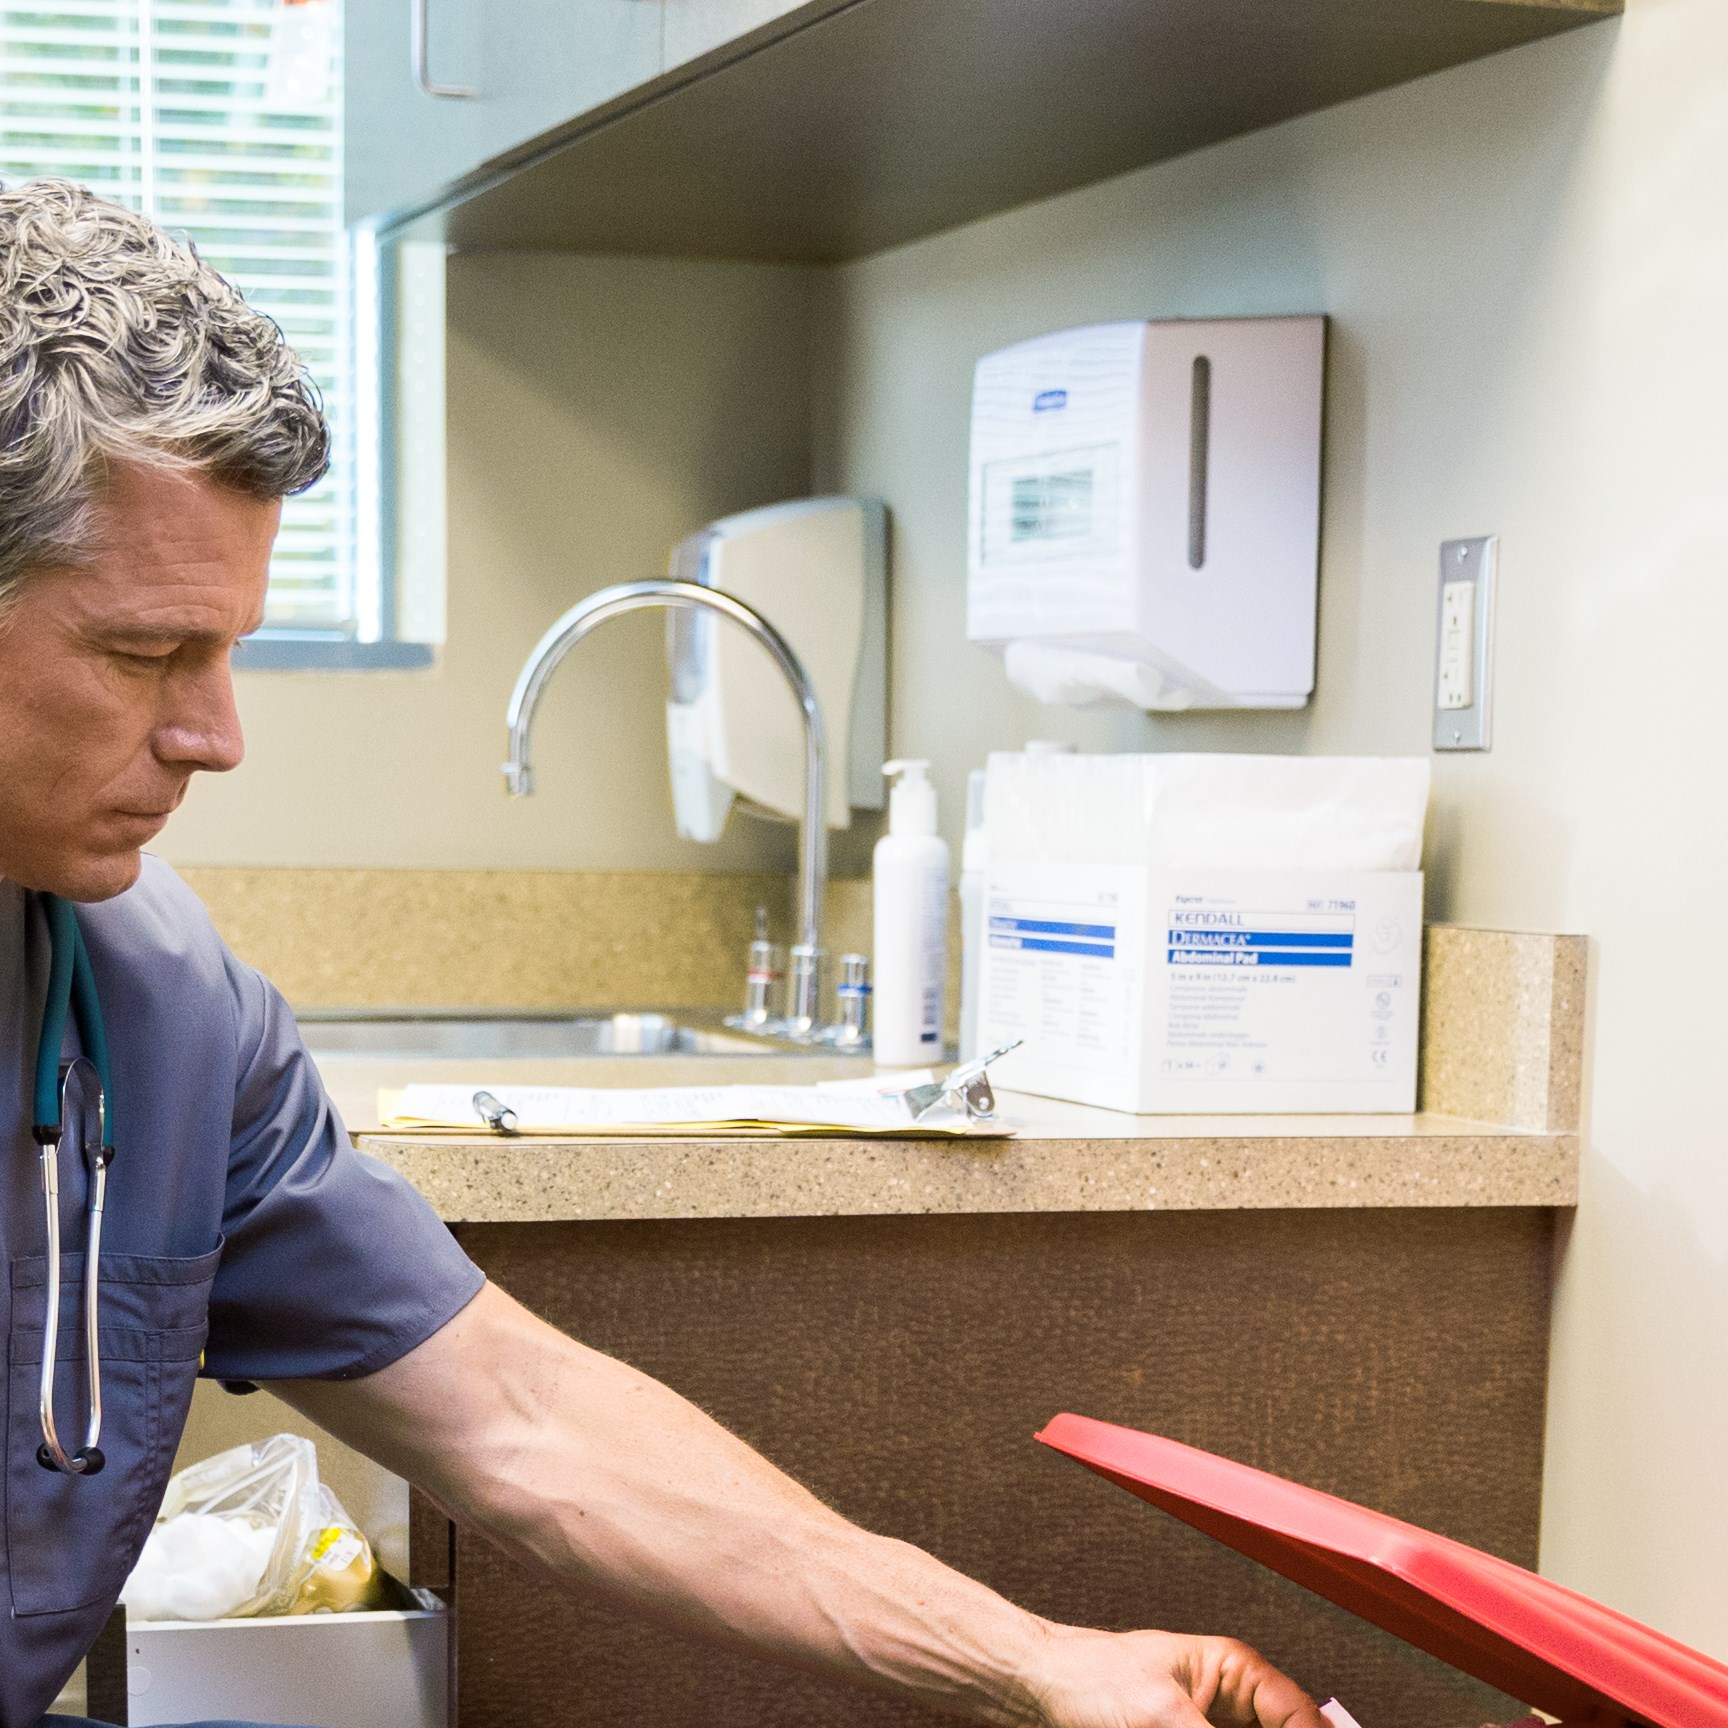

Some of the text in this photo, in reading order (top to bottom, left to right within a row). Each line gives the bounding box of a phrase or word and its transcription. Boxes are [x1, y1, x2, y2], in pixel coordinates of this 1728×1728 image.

[1175, 913, 1244, 926] KENDALL
[1173, 950, 1258, 965] Abdominal Pad
